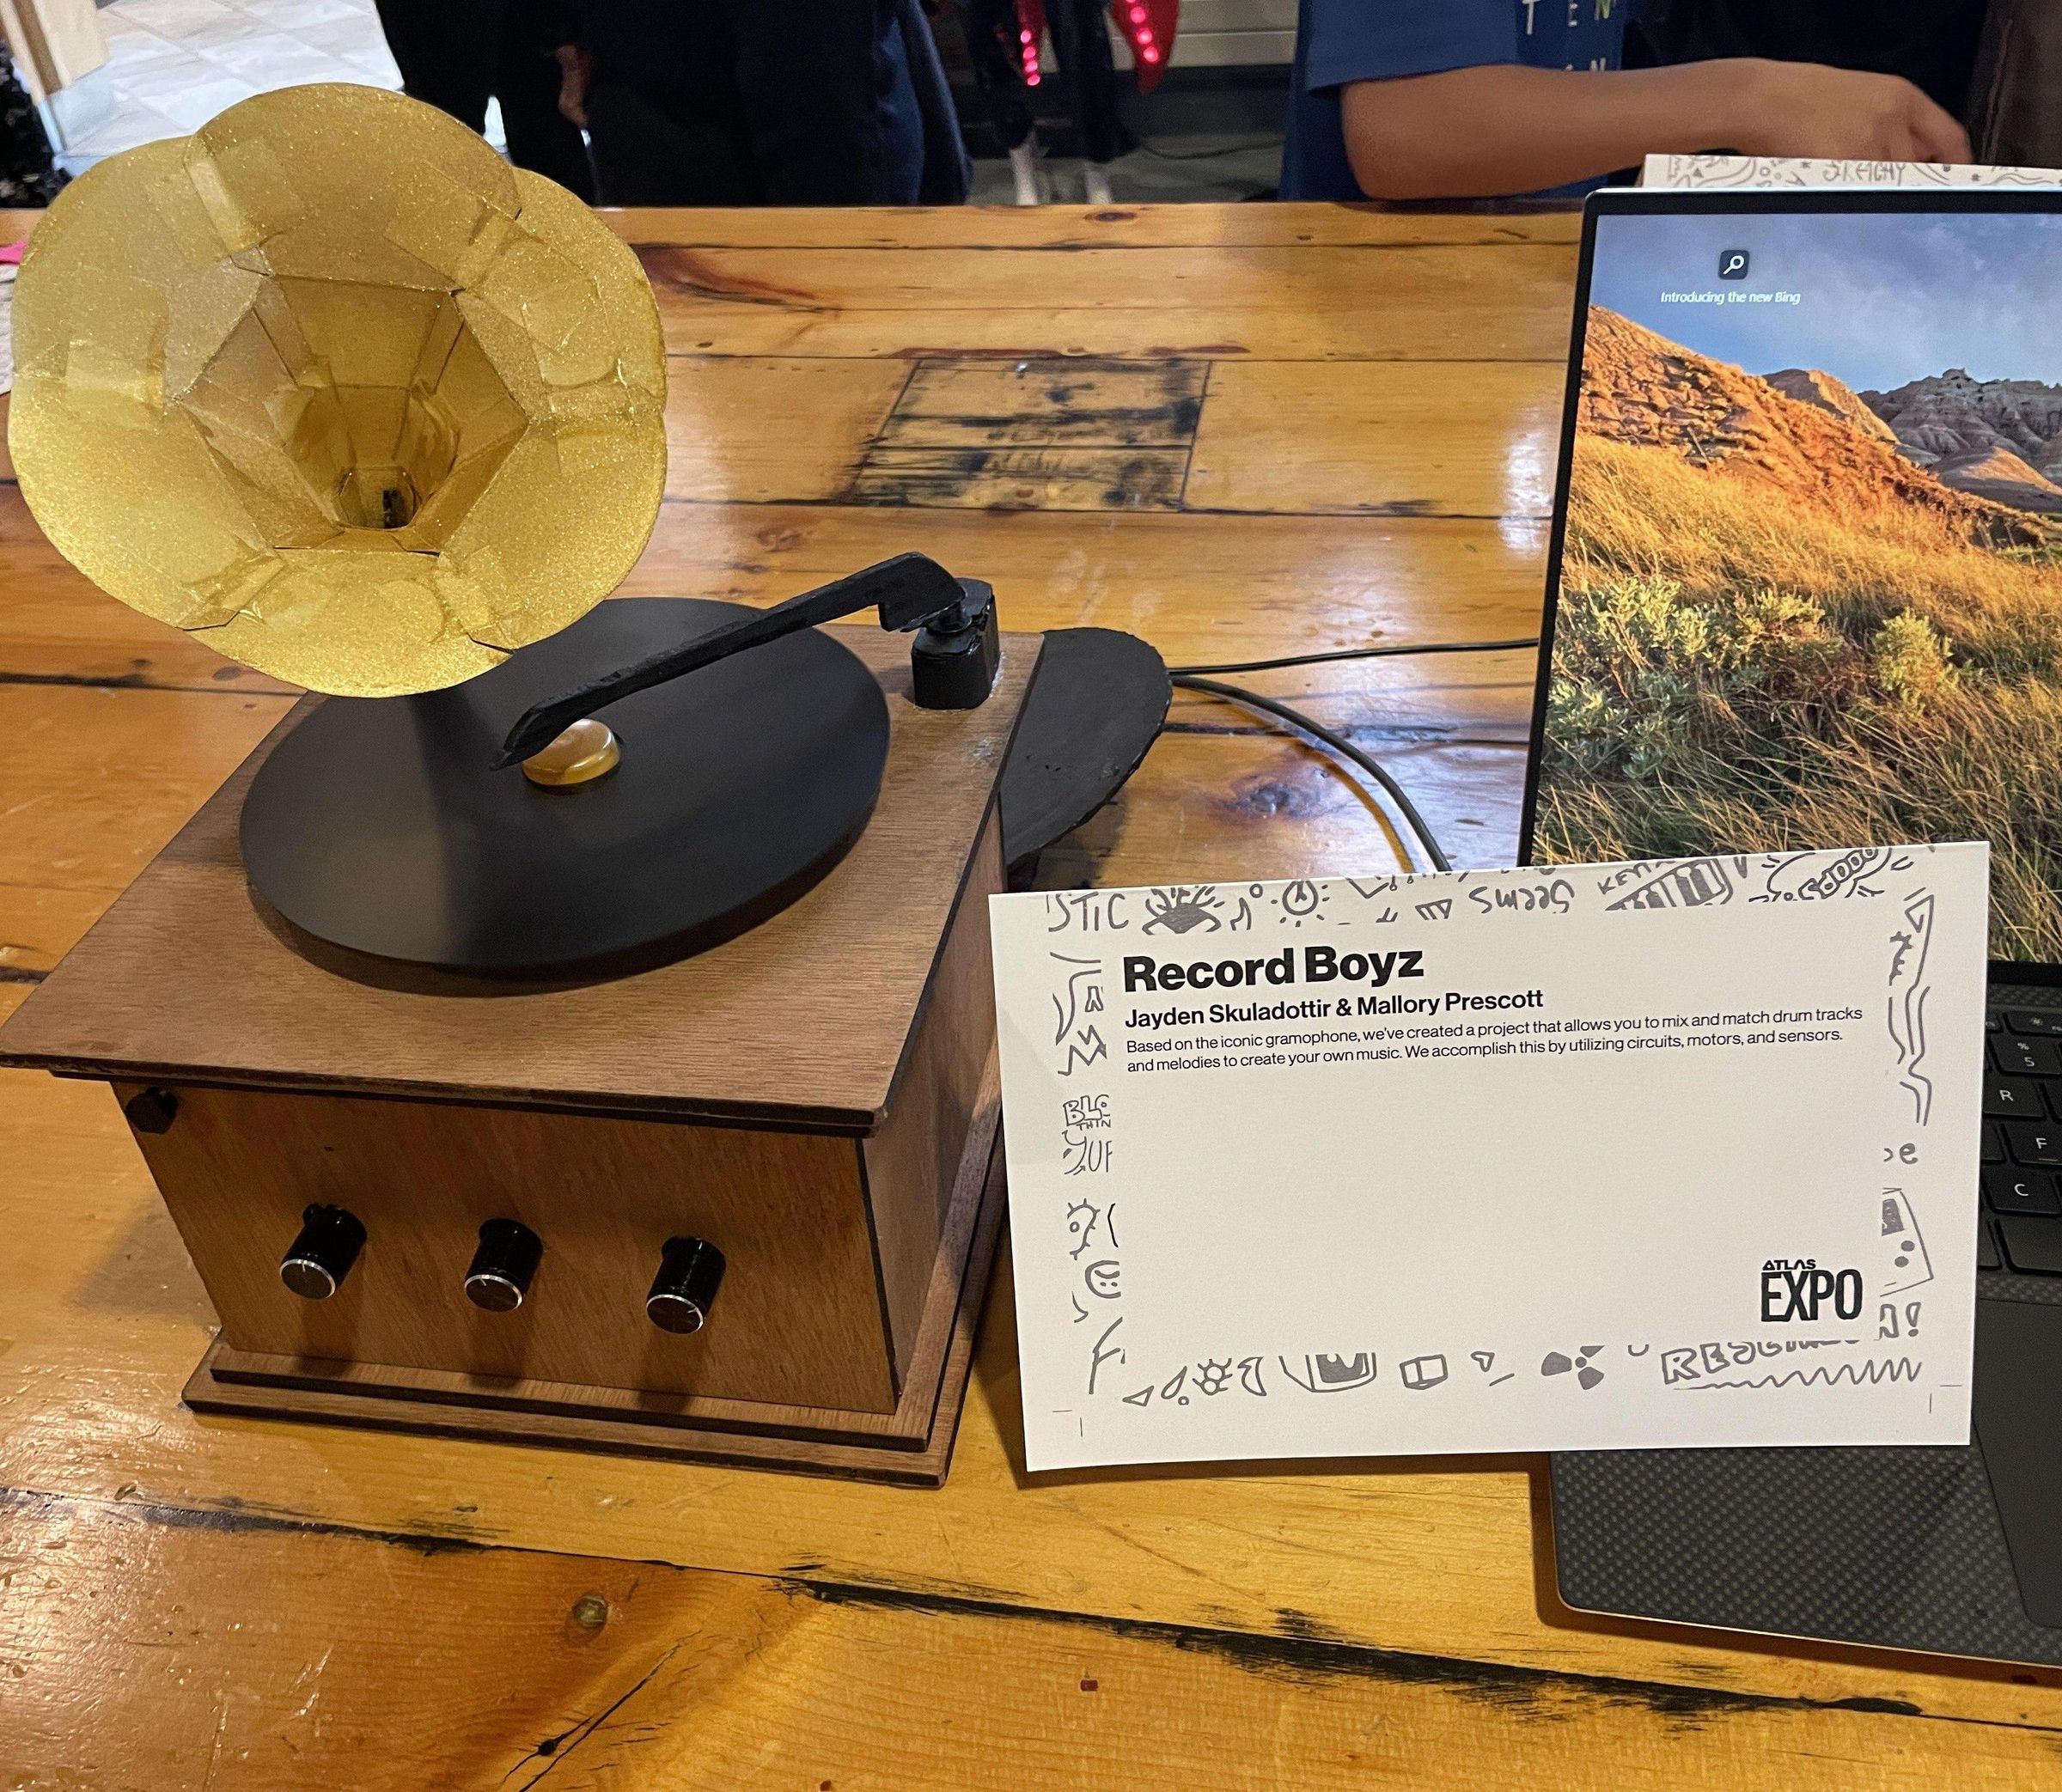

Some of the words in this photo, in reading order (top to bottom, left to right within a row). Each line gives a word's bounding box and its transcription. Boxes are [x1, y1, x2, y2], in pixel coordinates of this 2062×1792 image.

[1661, 290, 1724, 305] Introducing
[1728, 291, 1747, 302] the
[1748, 293, 1773, 302] new
[1775, 290, 1801, 305] Bing
[1123, 948, 1295, 992] Record
[1304, 946, 1424, 987] Boyz
[1125, 1006, 1205, 1030] Jayden
[1209, 999, 1332, 1023] Skuladottir
[1336, 998, 1353, 1016] &
[1357, 995, 1441, 1015] Mallory
[1445, 990, 1544, 1011] Prescott
[1127, 1039, 1171, 1052] Based
[1175, 1041, 1192, 1050] on
[1196, 1037, 1217, 1049] the
[1222, 1034, 1262, 1047] iconic
[1266, 1031, 1361, 1048] gramophone,
[1363, 1027, 1404, 1040] we've
[1406, 1024, 1463, 1038] created
[1467, 1027, 1475, 1035] a
[1479, 1022, 1529, 1038] project
[1533, 1021, 1561, 1033] that
[1565, 1020, 1611, 1032] allows
[1614, 1020, 1641, 1032] you
[1645, 1017, 1659, 1028] to
[1662, 1015, 1688, 1027] mix
[1692, 1014, 1719, 1026] and
[1723, 1011, 1769, 1024] match
[1773, 1010, 1812, 1022] drum
[1816, 1008, 1862, 1021] tracks
[1128, 1059, 1153, 1072] and
[1157, 1057, 1220, 1070] melodies
[1223, 1056, 1237, 1066] to
[1241, 1053, 1285, 1066] create
[1288, 1053, 1320, 1066] your
[1323, 1051, 1353, 1062] own
[1357, 1047, 1402, 1060] music.
[1405, 1045, 1429, 1058] We
[1432, 1042, 1516, 1057] accomplish
[1520, 1041, 1545, 1053] this
[1549, 1040, 1566, 1054] by
[1570, 1038, 1623, 1051] utilizing
[1627, 1035, 1684, 1048] circuits,
[1687, 1033, 1743, 1045] motors,
[1748, 1031, 1774, 1044] and
[1778, 1031, 1842, 1042] sensors.
[2024, 1057, 2035, 1067] 5
[1999, 1089, 2014, 1101] R
[2035, 1137, 2048, 1149] F
[2014, 1184, 2028, 1197] C
[1762, 1259, 1816, 1271] ATLAS
[1760, 1269, 1863, 1322] EXPO
